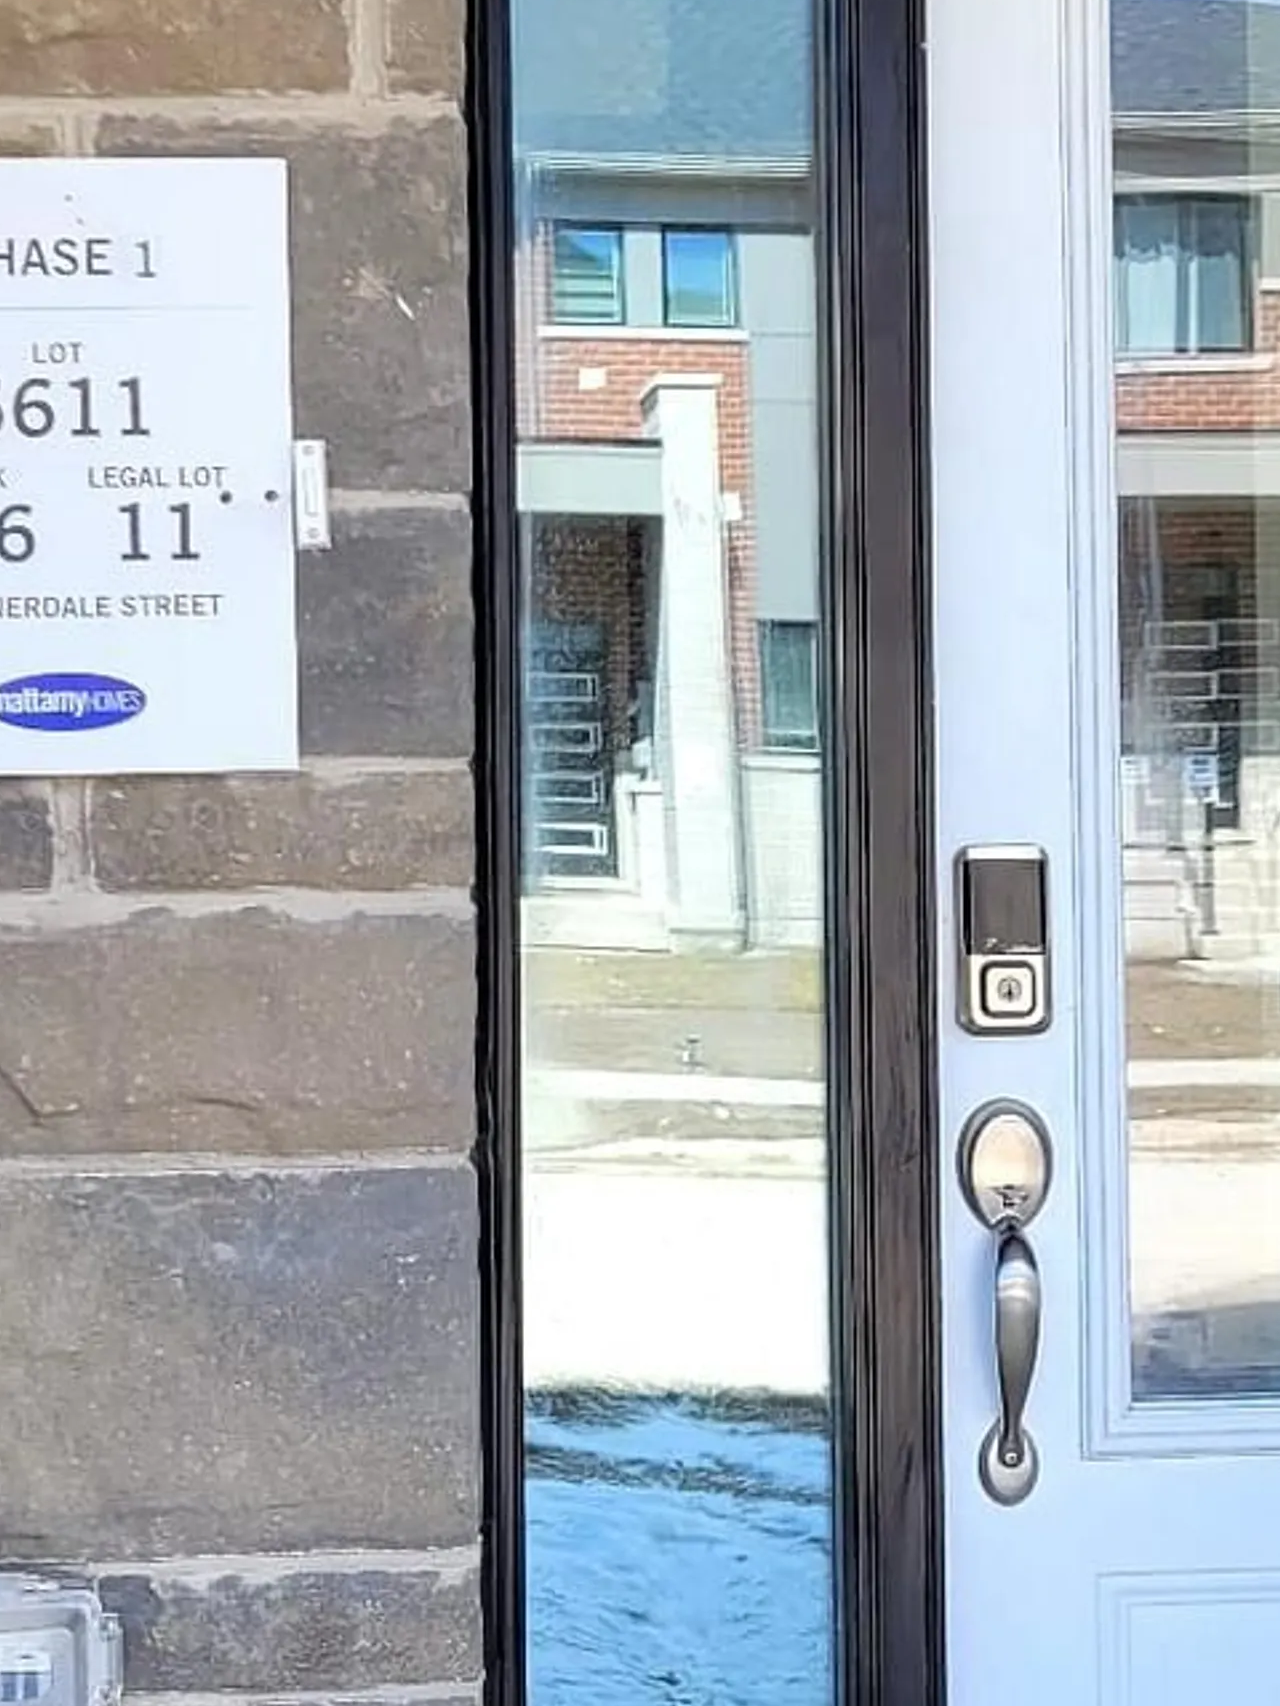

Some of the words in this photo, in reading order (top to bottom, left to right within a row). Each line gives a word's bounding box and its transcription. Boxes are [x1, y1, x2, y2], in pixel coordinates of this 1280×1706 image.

[135, 240, 157, 279] 1
[31, 341, 83, 364] LOT
[87, 465, 170, 489] LEGAL
[178, 465, 227, 488] LOT
[118, 502, 201, 562] 11
[120, 593, 224, 618] STREET
